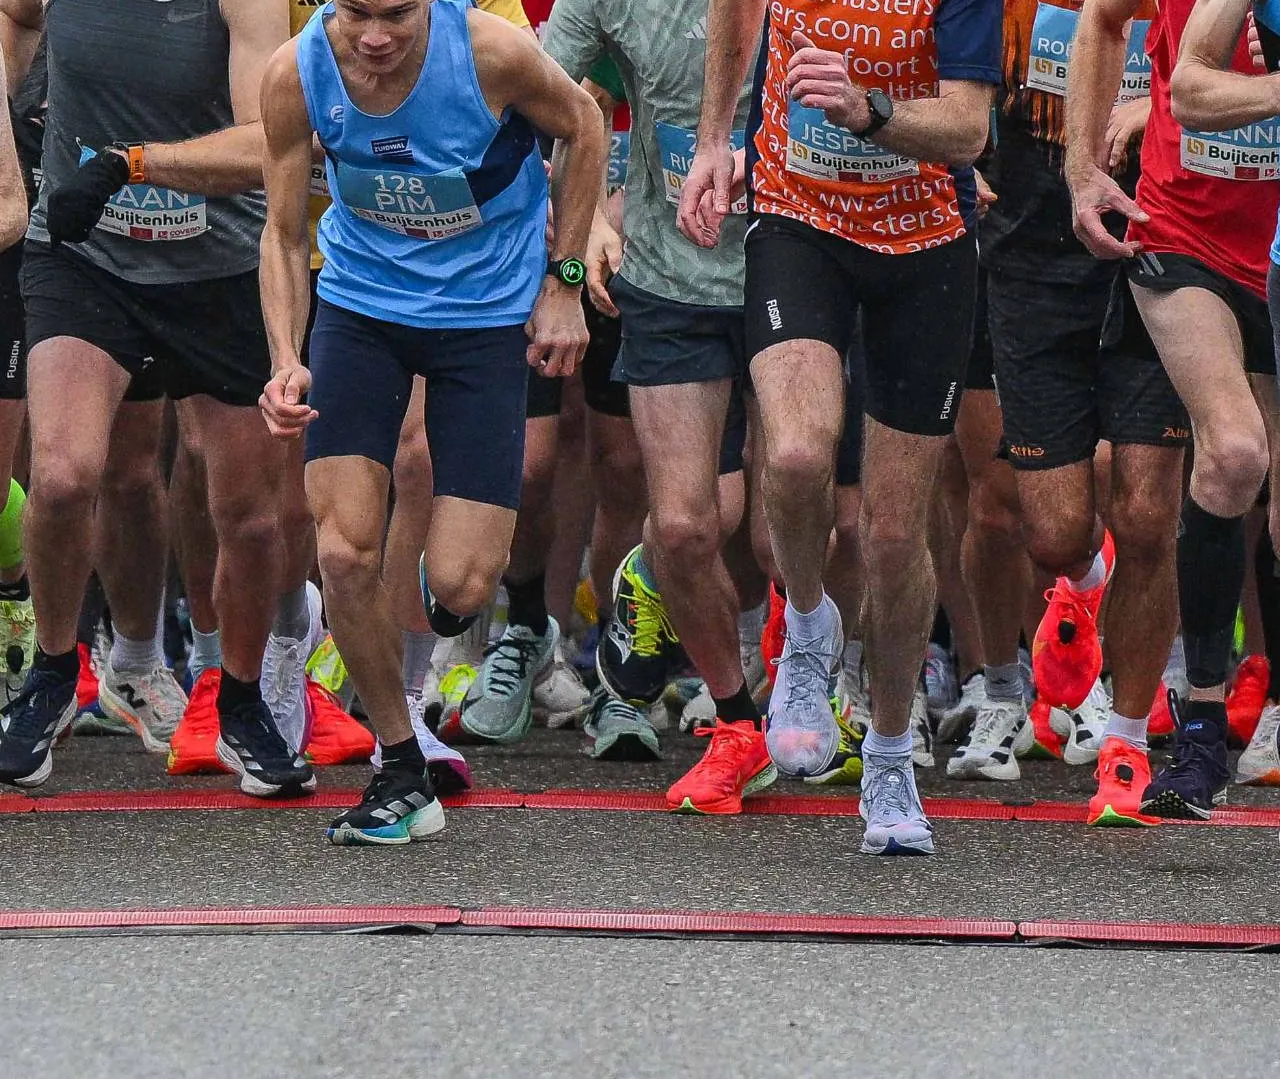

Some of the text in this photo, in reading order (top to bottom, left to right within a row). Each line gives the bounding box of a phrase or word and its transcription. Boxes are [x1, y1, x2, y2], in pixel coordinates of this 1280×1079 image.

[802, 123, 883, 154] JESPE
[811, 153, 910, 176] Buijtenhuis
[374, 173, 426, 195] 128
[374, 192, 436, 213] PIM
[104, 206, 199, 226] Buijtenhuis
[374, 211, 473, 229] Buijtenhuis
[766, 298, 783, 331] FUSION
[6, 340, 21, 379] FUSION
[940, 381, 957, 420] FUSION
